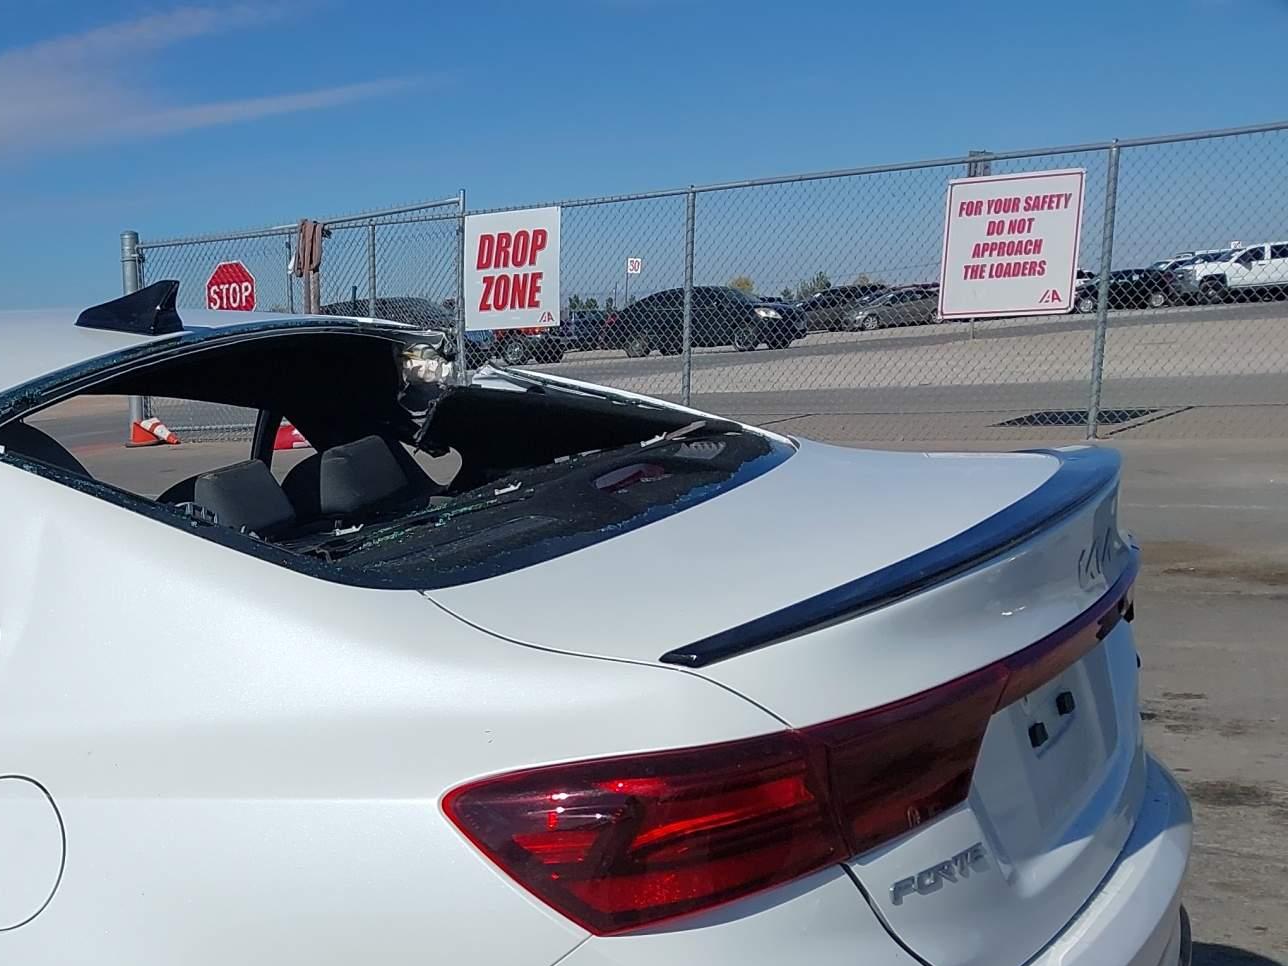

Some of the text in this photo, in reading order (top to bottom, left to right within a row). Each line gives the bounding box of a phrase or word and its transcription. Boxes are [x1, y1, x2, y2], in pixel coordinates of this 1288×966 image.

[958, 193, 1073, 218] FOR YOUR SAFETY
[986, 217, 1035, 237] DO NOT
[476, 228, 548, 271] DROP
[971, 238, 1043, 259] APPROACH
[963, 260, 1047, 281] THE LOADERS
[210, 282, 252, 310] STOP
[478, 271, 544, 313] ZONE
[890, 842, 988, 906] FORTE
